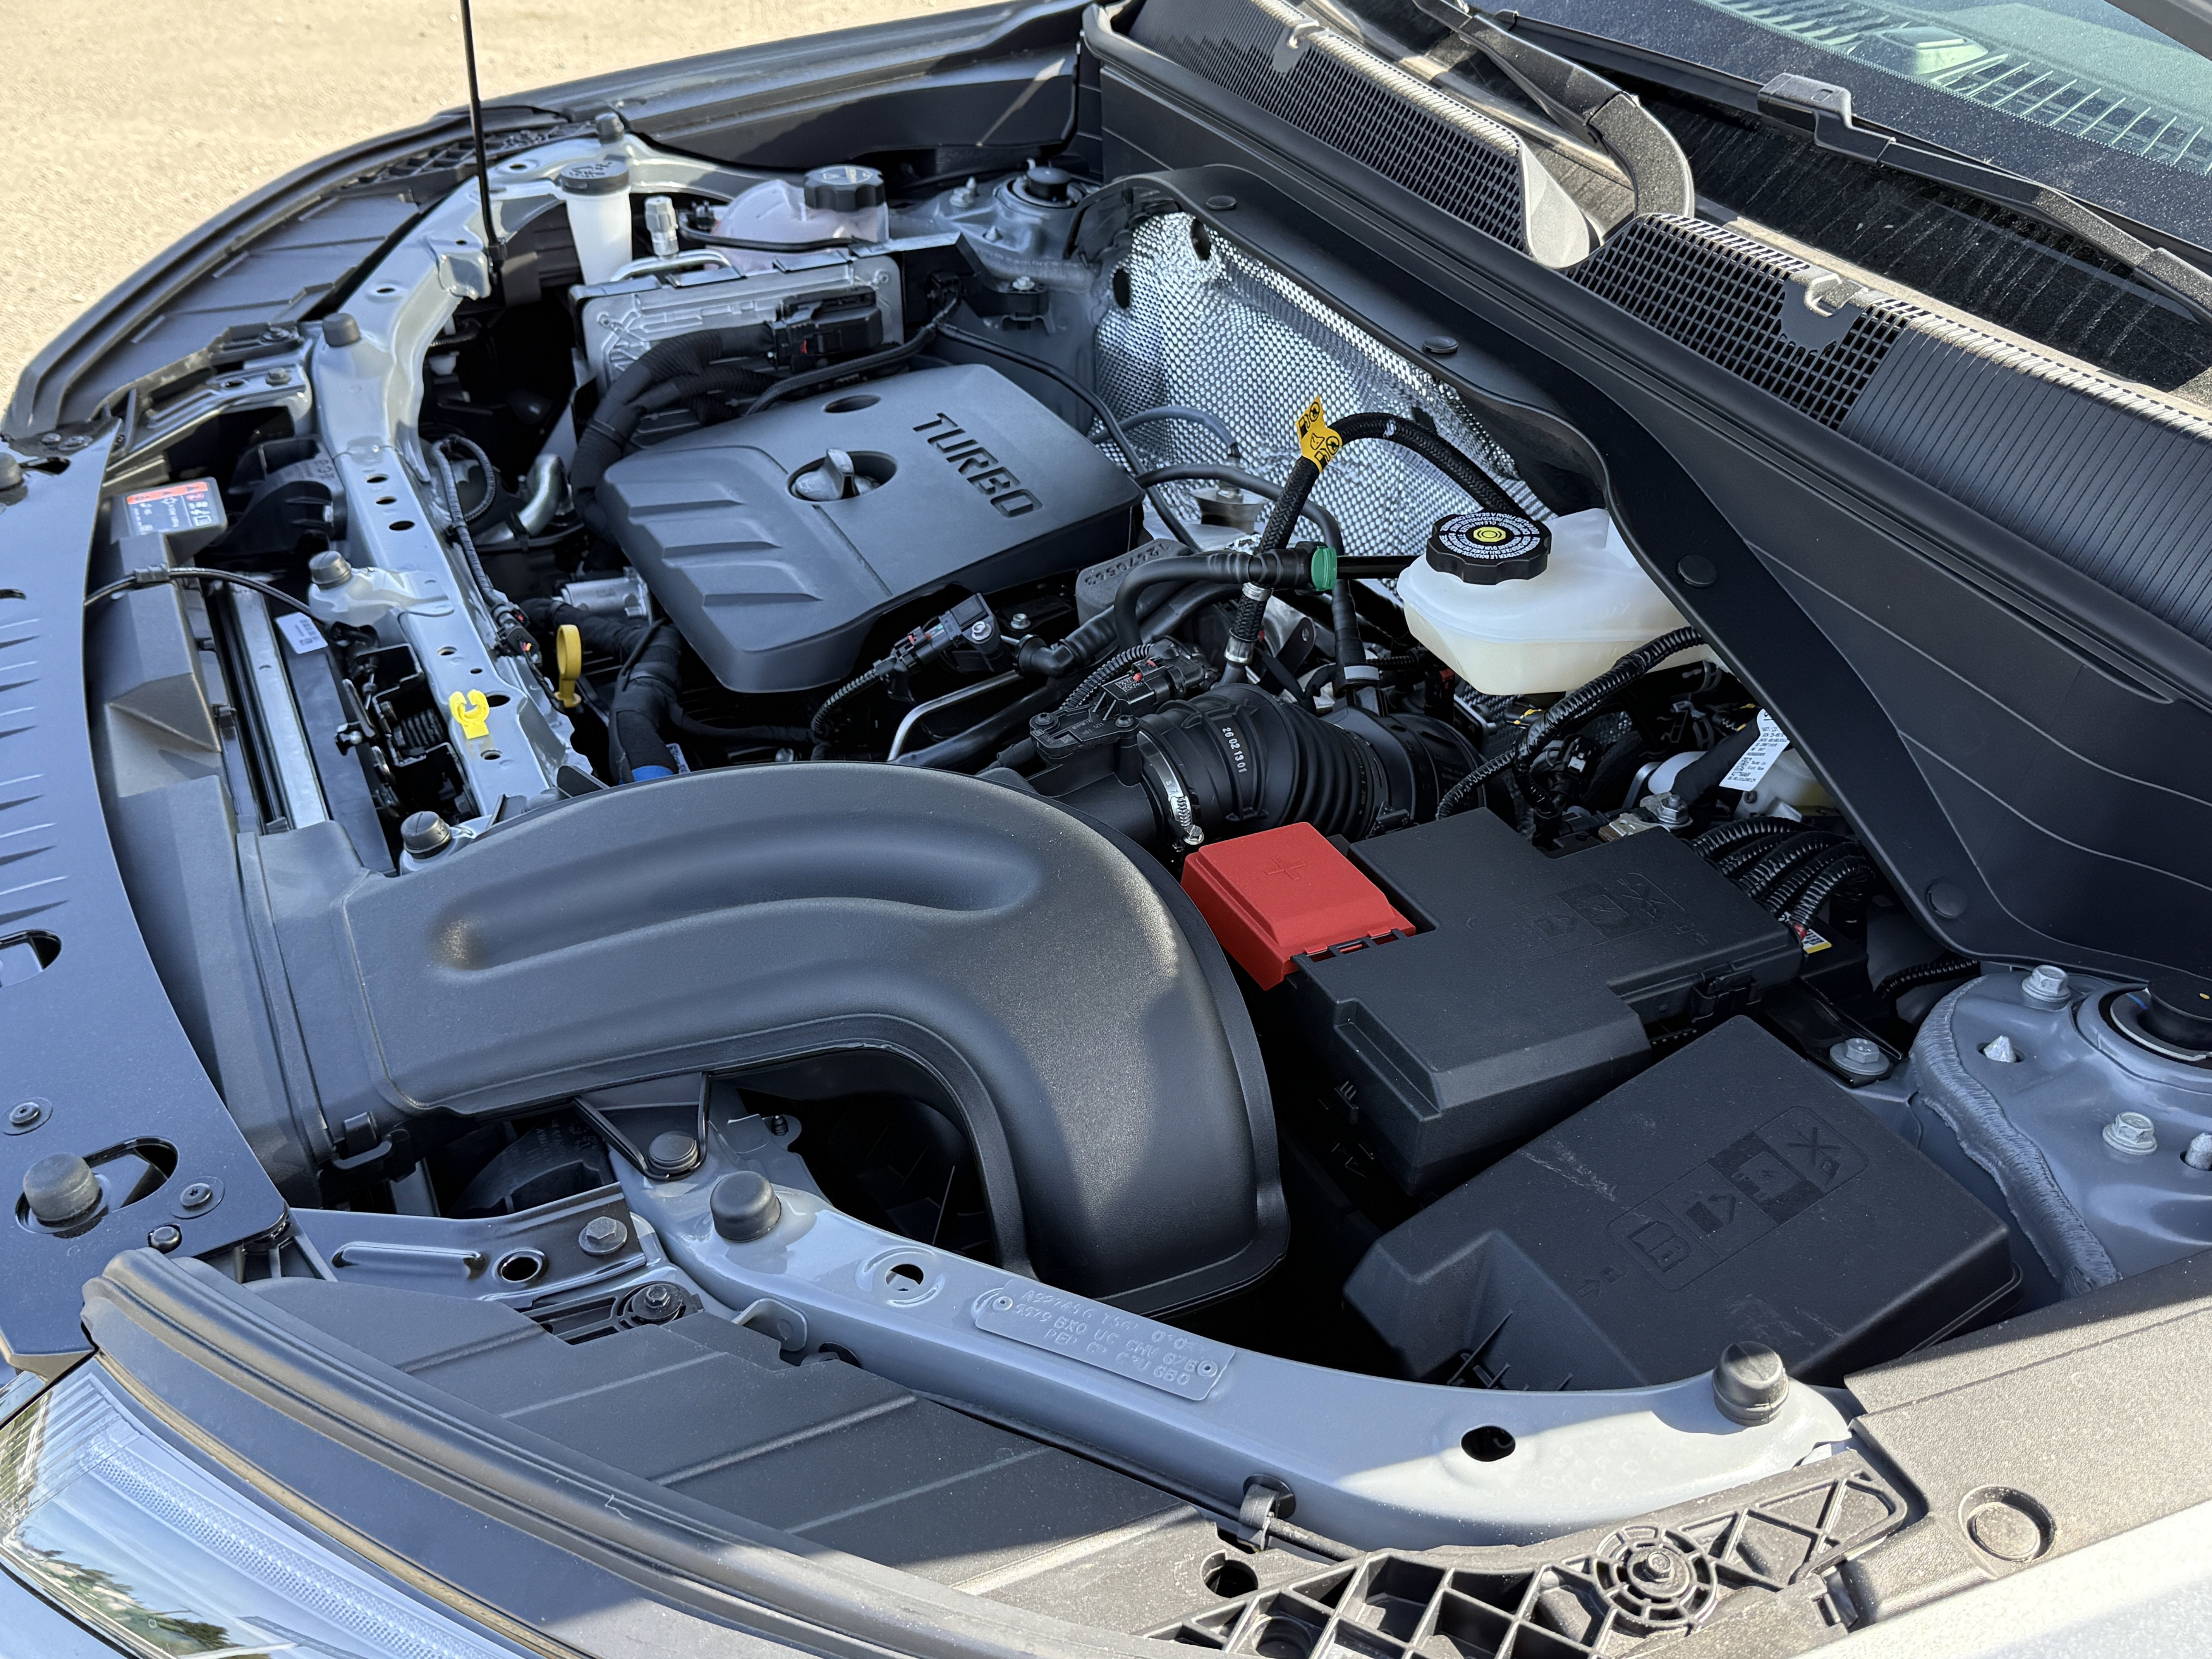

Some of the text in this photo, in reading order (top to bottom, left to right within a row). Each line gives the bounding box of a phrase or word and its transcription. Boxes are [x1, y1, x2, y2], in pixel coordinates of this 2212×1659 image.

[912, 412, 1043, 518] TURBO
[1222, 727, 1248, 773] 26 02 13 01
